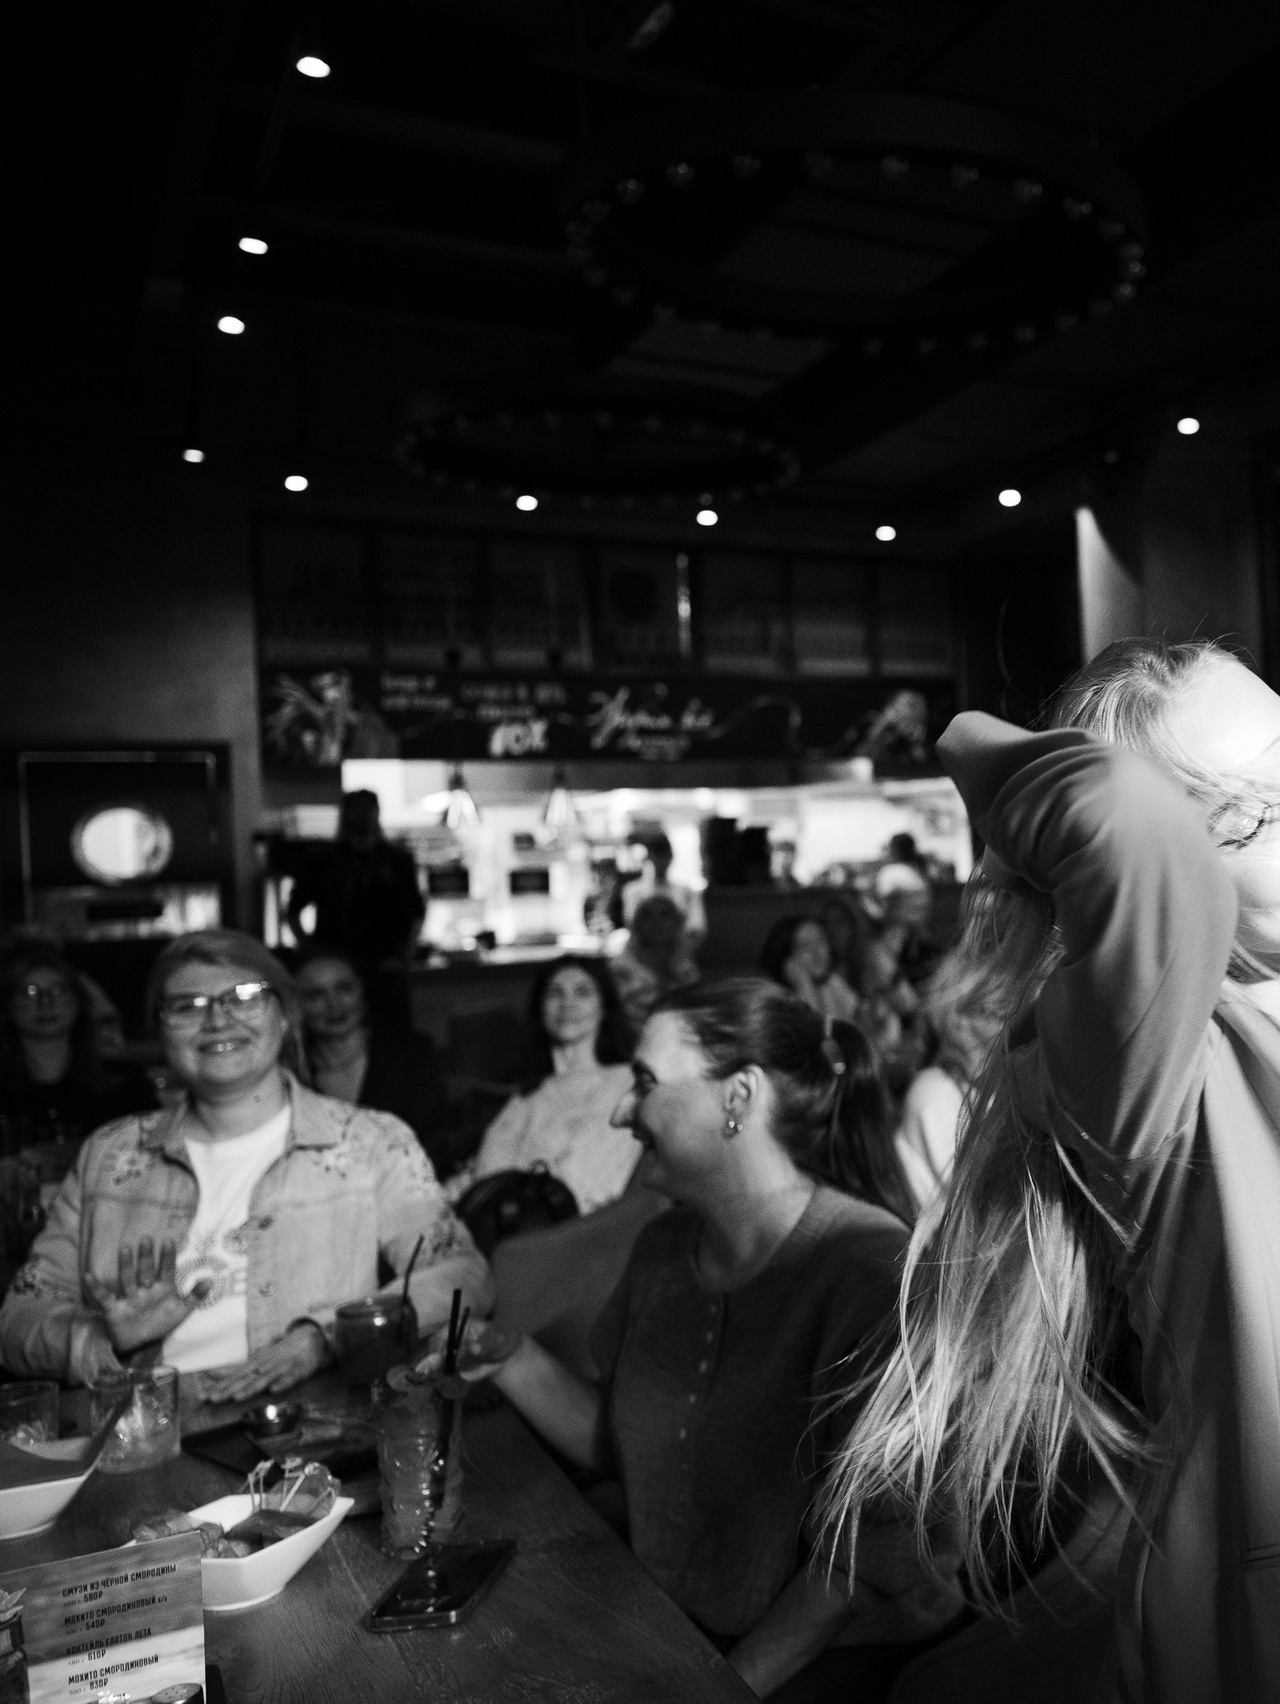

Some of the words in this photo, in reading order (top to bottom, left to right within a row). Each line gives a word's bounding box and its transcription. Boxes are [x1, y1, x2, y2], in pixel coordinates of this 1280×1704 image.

[62, 1584, 88, 1597] СМУЗИ
[89, 1581, 99, 1591] ИЗ
[130, 1564, 176, 1582] СМОРОДИНЫ
[64, 1610, 94, 1626] МОХИТО
[96, 1595, 156, 1618] СМОРОДИНОВЫЙ
[66, 1639, 104, 1655] КОКТЕЙЛЬ
[105, 1632, 133, 1647] ГЛОТОК
[134, 1628, 152, 1639] ЛЕТА
[68, 1670, 98, 1685] МОХИТО
[99, 1653, 159, 1678] СМОРОДИНОВЫЙ
